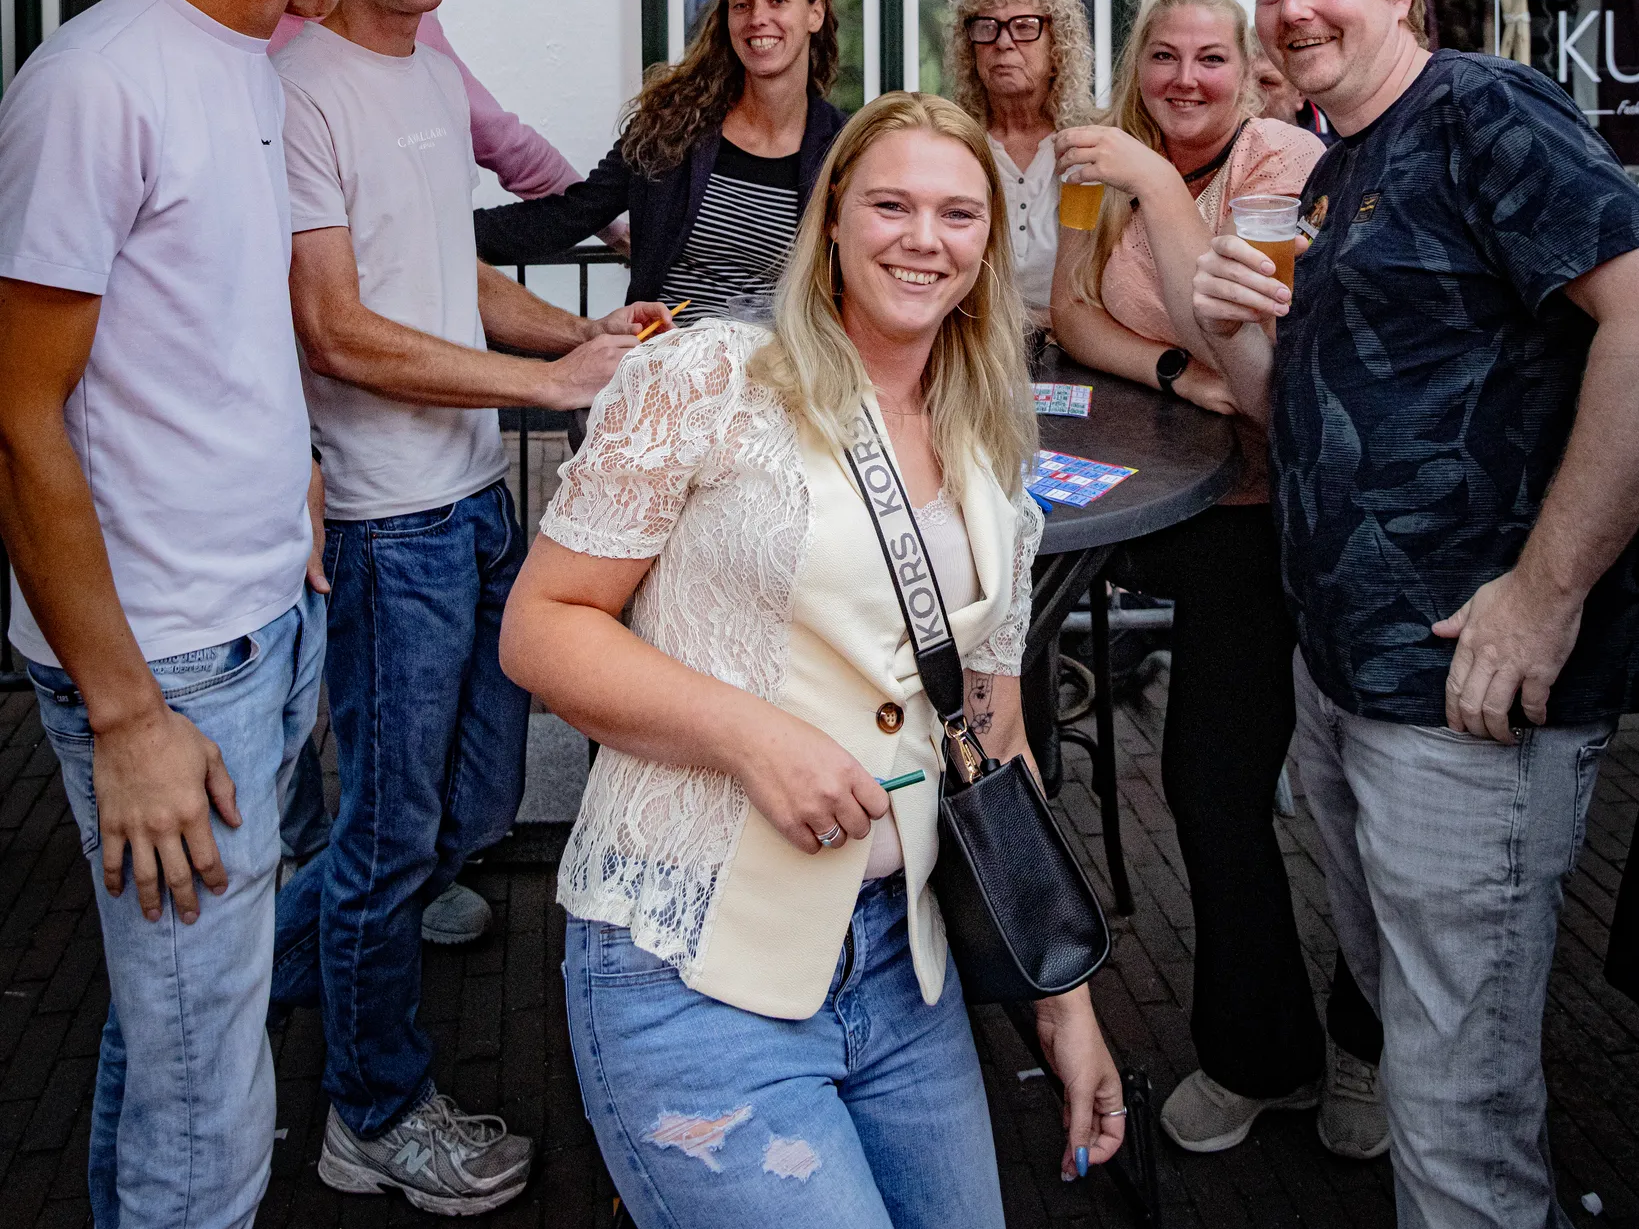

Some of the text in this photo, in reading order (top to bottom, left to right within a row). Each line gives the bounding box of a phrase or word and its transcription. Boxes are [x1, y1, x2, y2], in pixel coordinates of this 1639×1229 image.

[1558, 10, 1639, 83] KU
[891, 532, 944, 644] KORS
[394, 1139, 432, 1174] N
